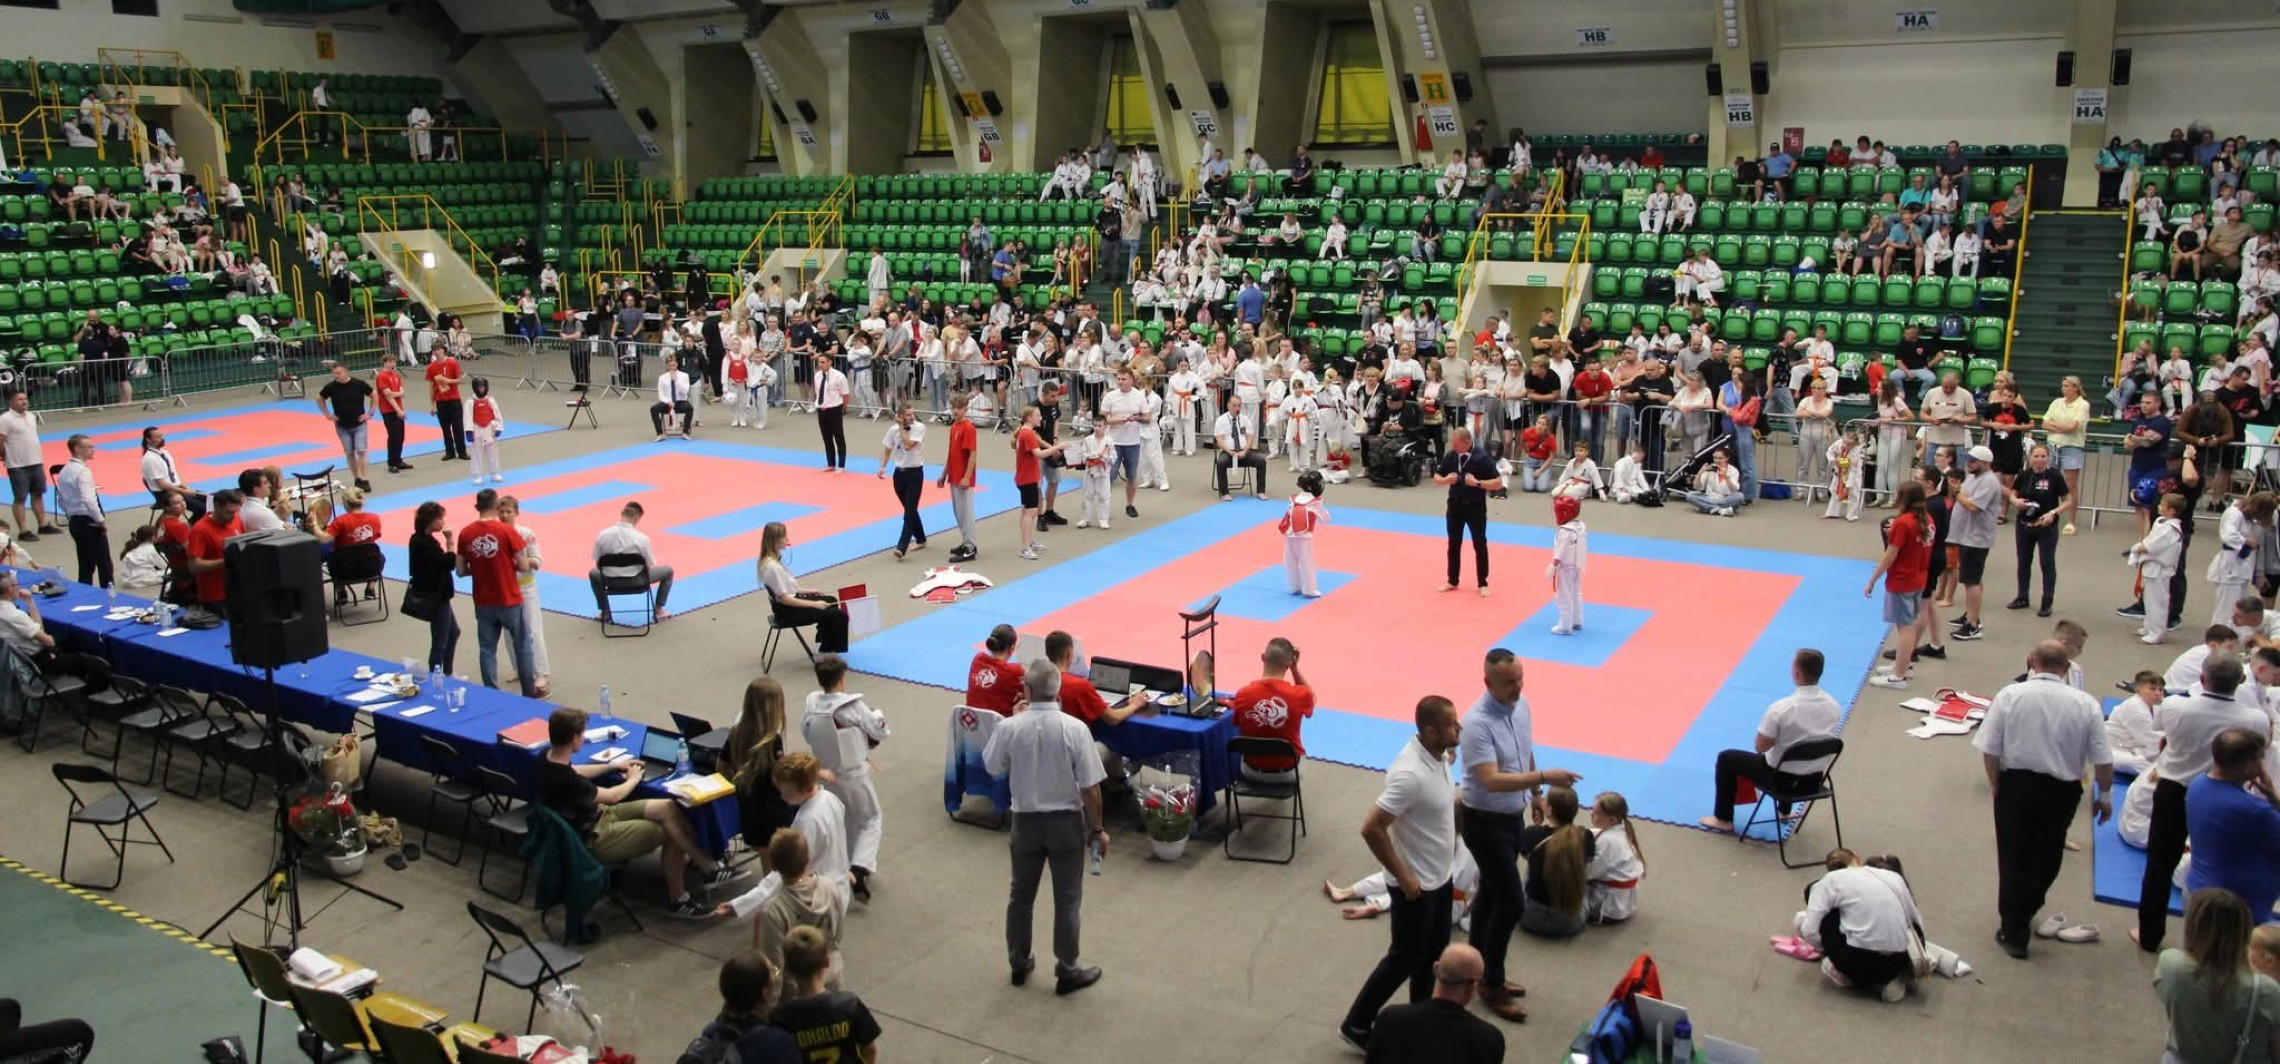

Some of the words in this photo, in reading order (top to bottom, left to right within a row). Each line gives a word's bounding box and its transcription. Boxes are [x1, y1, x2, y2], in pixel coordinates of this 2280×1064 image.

[1904, 15, 1929, 26] HA
[1584, 31, 1606, 41] HB
[1426, 83, 1446, 99] H
[1729, 111, 1752, 122] HB
[2076, 106, 2104, 117] HA
[1198, 123, 1216, 132] GC
[1434, 121, 1455, 132] HC
[983, 132, 1000, 141] GB
[797, 1020, 849, 1047] ONALDO
